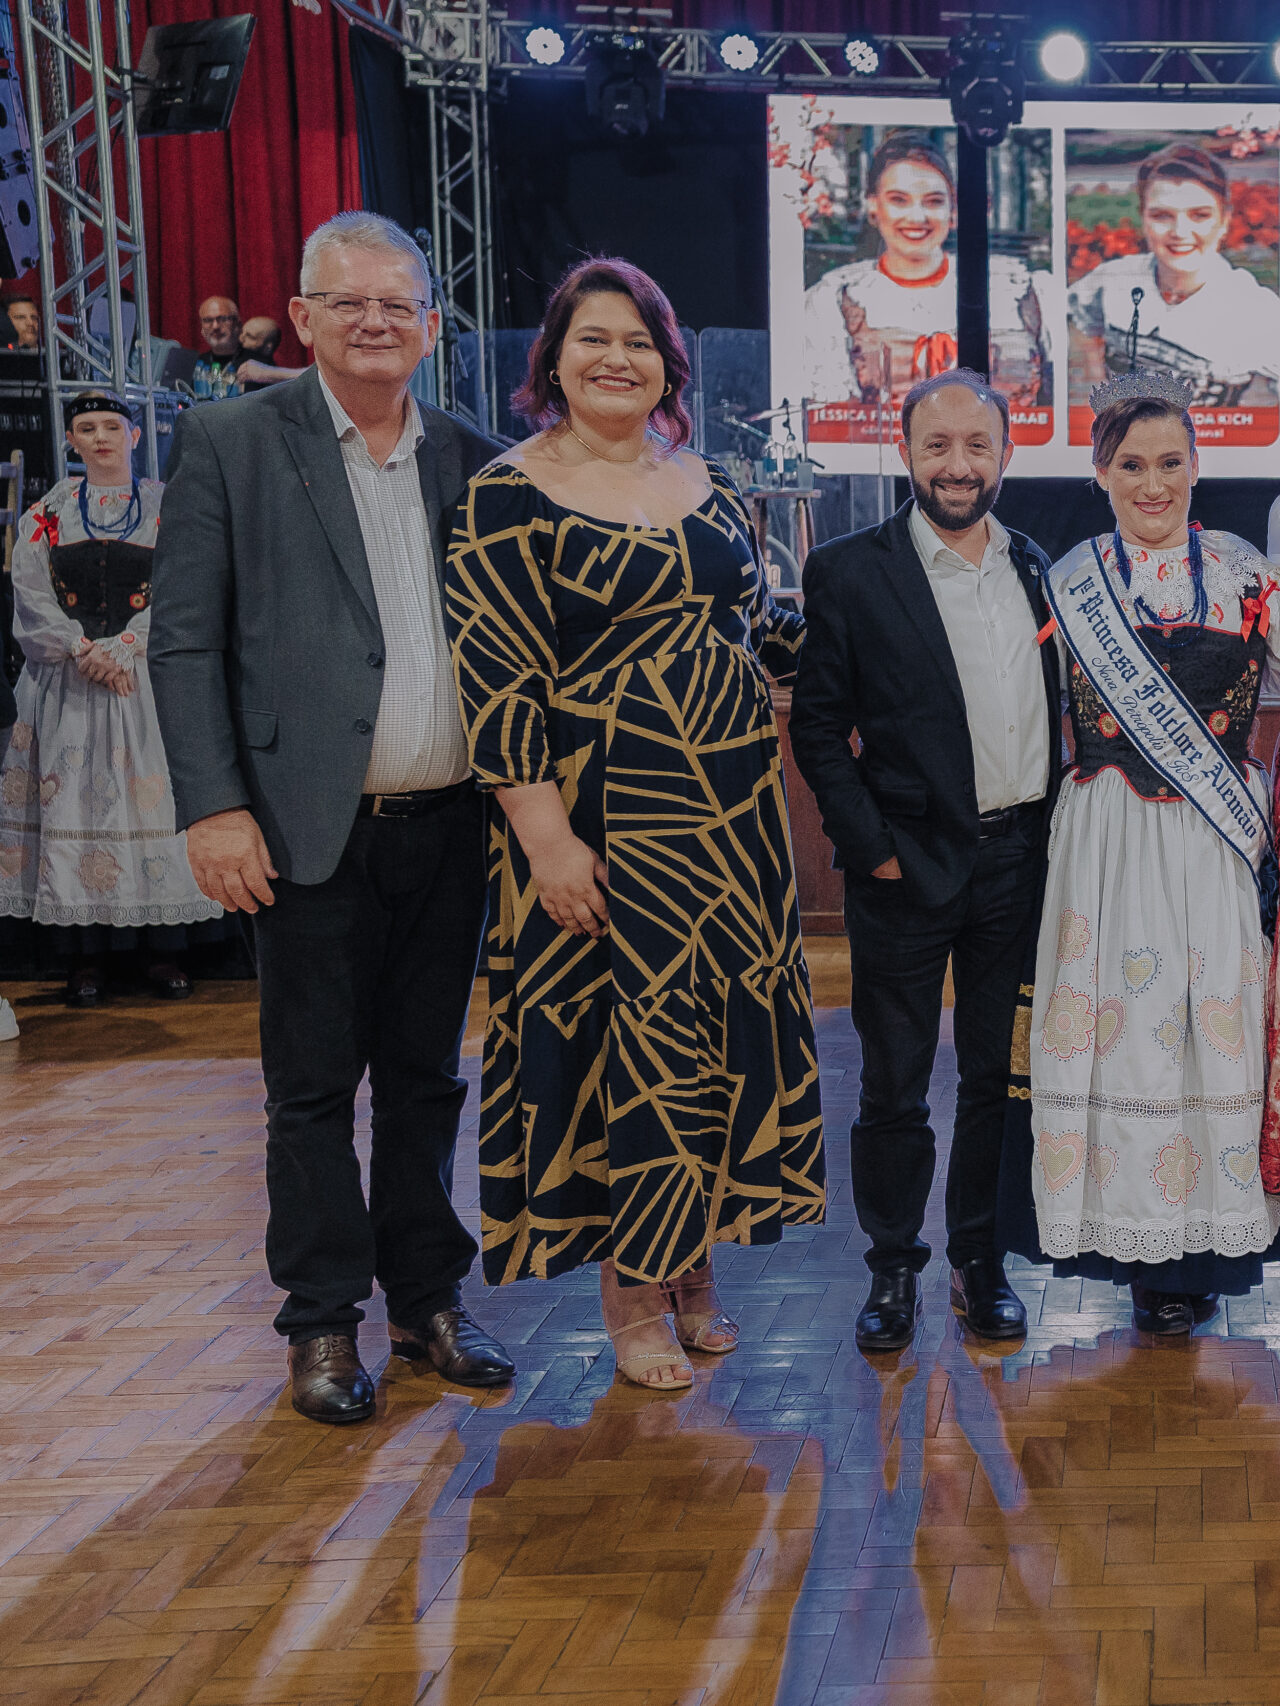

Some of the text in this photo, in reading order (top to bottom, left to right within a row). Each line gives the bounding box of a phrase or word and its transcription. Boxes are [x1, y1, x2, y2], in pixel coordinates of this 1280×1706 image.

[1009, 411, 1049, 425] HAAB
[1076, 591, 1140, 683] Princesa
[1132, 677, 1204, 765] Folclore
[1200, 761, 1258, 840] Alemão
[1091, 657, 1119, 692] Nova
[1117, 695, 1167, 751] Petrópolis
[1166, 759, 1200, 783] RS
